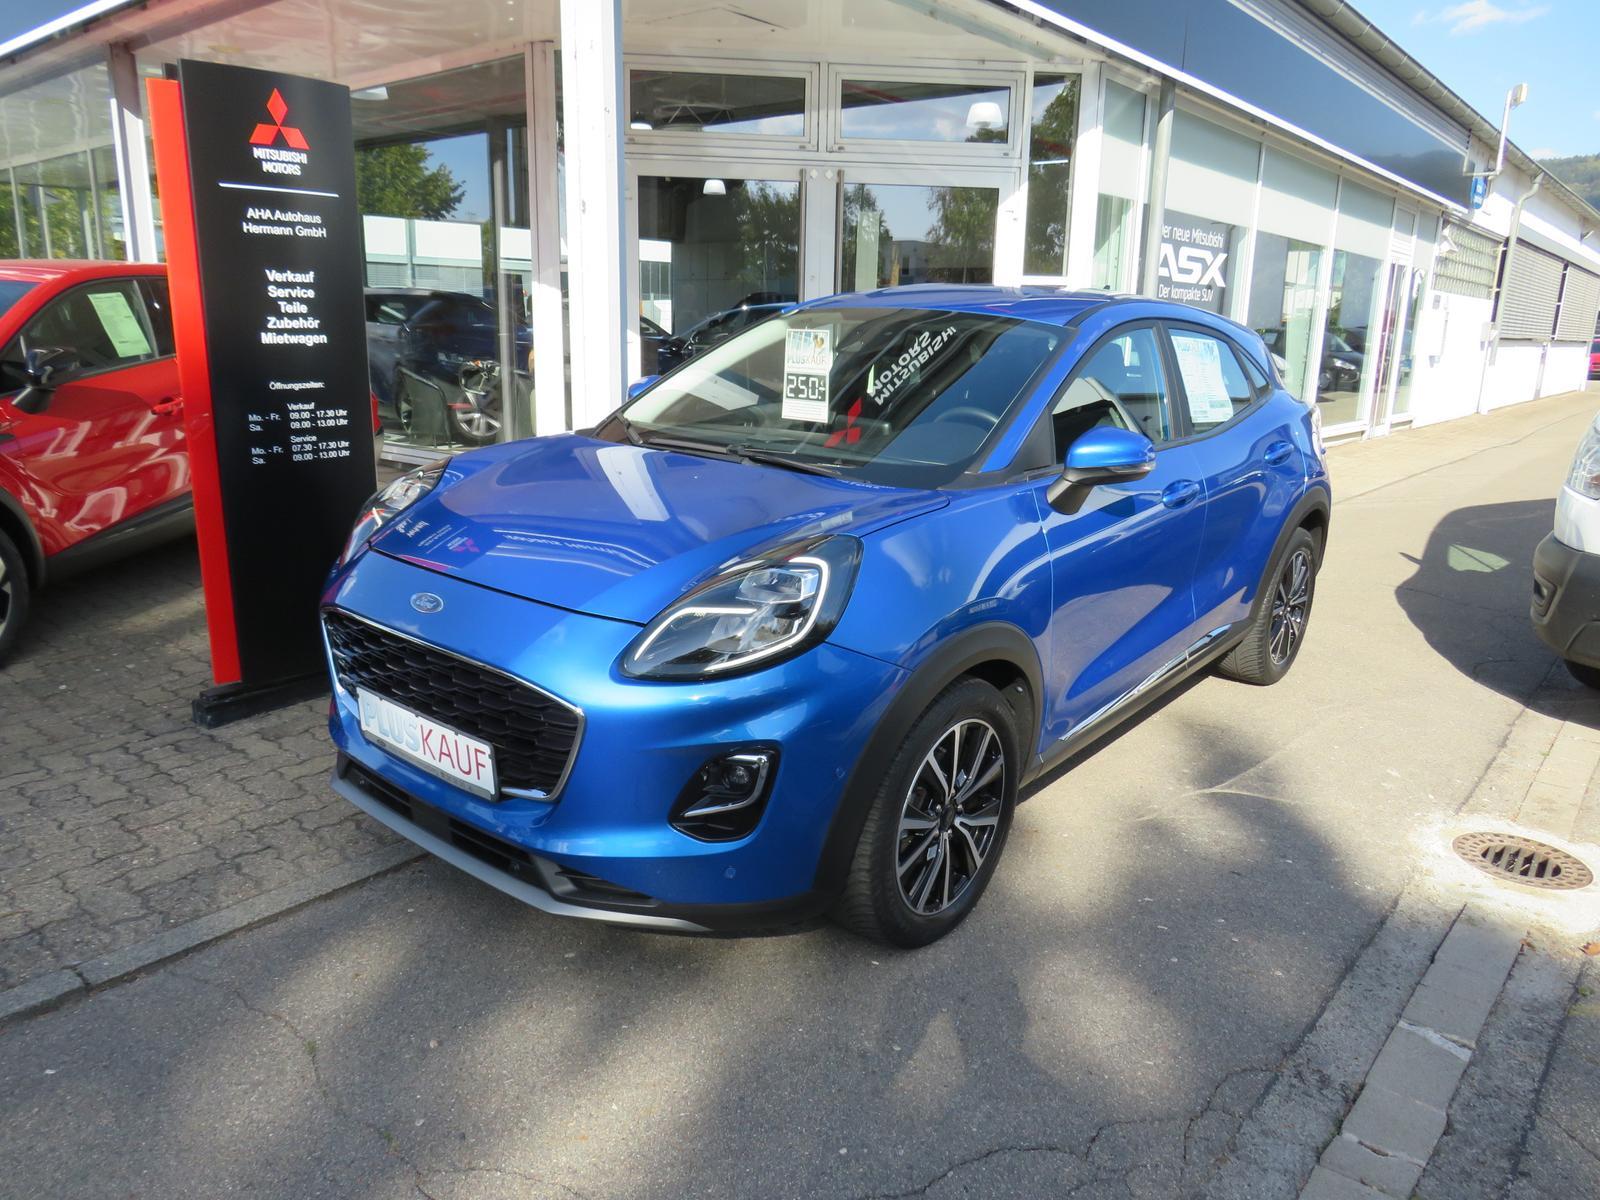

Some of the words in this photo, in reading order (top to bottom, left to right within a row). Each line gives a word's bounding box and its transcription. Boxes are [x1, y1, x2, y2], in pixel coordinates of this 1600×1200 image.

[252, 147, 308, 164] MITSUBISHI
[262, 161, 301, 175] MOTORS
[246, 207, 274, 220] AHA
[274, 210, 322, 224] Autohaus
[242, 222, 293, 236] Hermann
[295, 225, 327, 238] GmbH
[1172, 227, 1190, 242] neue
[1191, 228, 1224, 248] Mitsubishi
[1158, 242, 1228, 288] ASX
[265, 269, 315, 283] Verkauf
[267, 285, 315, 299] Service
[1158, 284, 1170, 298] Der
[1171, 285, 1201, 302] kompakte
[1201, 288, 1214, 302] SUV
[278, 301, 308, 314] Teile
[266, 316, 320, 330] Zubehör
[260, 332, 328, 346] Mietwagen
[287, 402, 315, 411] Verkauf
[289, 411, 311, 419] 09.00
[316, 409, 335, 418] 17.30
[335, 408, 348, 416] Uhr
[248, 413, 264, 421] Mo.
[290, 421, 311, 429] 09.00
[317, 419, 336, 427] 13.00
[336, 418, 349, 426] Uhr
[290, 434, 317, 443] Service
[251, 447, 266, 455] Mo.
[291, 443, 313, 452] 07.30
[319, 441, 337, 450] 17.30
[337, 440, 350, 448] Uhr
[292, 453, 313, 461] 09.00
[319, 450, 338, 459] 13.00
[338, 449, 350, 457] Uhr
[362, 697, 487, 780] PLUSKAUF
